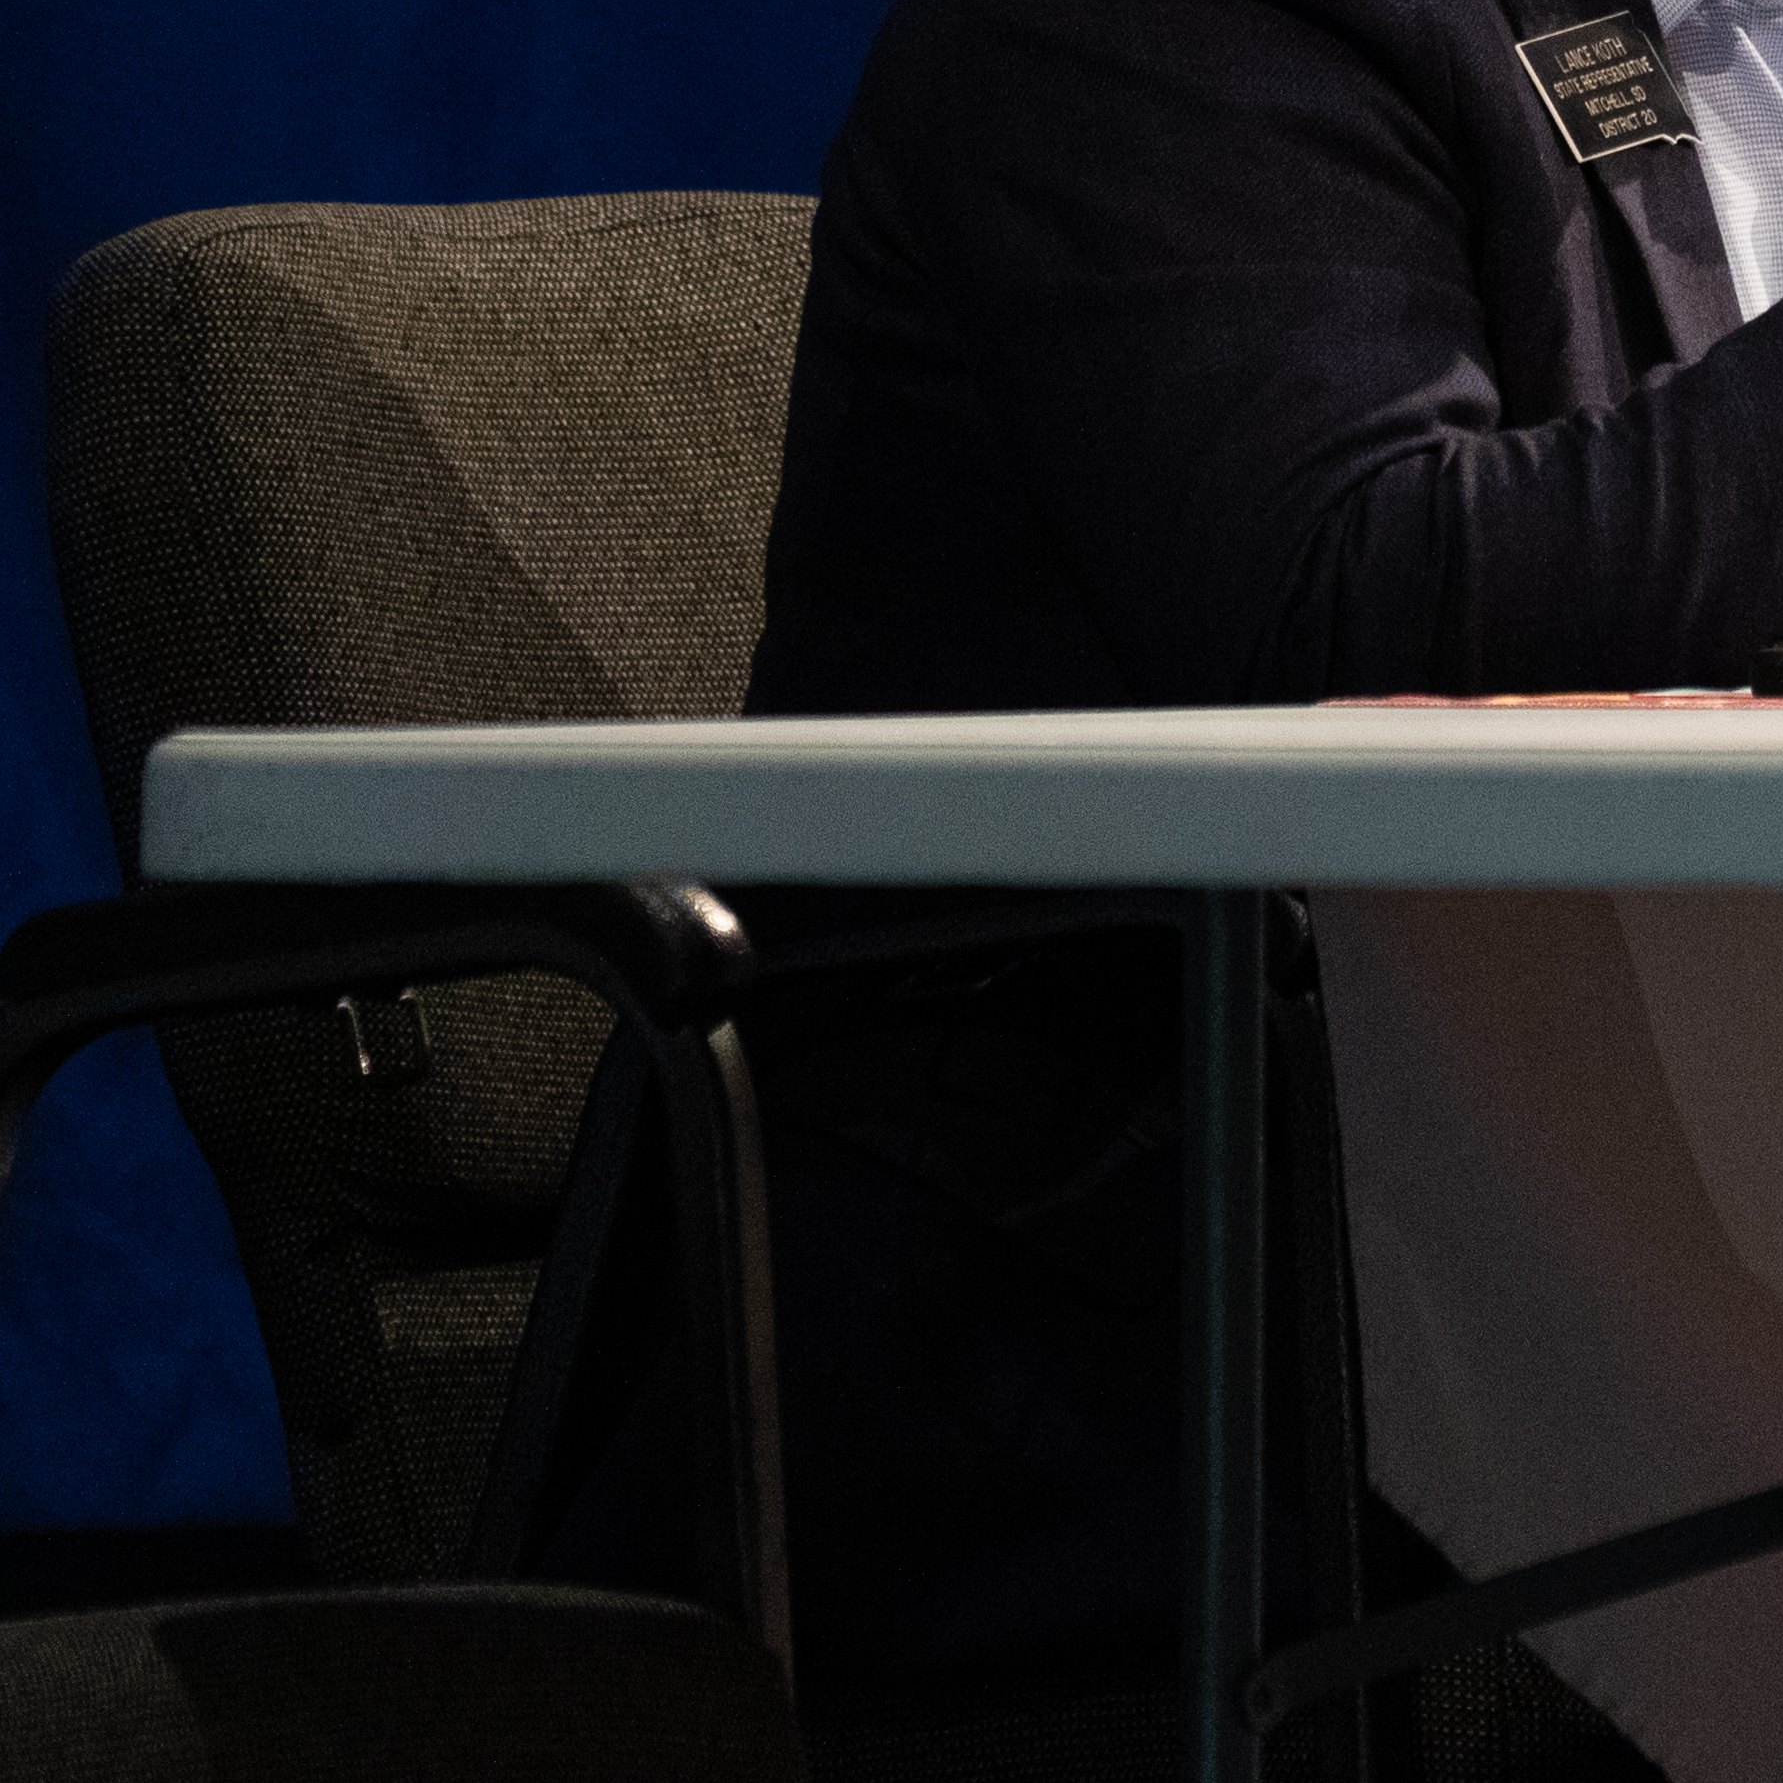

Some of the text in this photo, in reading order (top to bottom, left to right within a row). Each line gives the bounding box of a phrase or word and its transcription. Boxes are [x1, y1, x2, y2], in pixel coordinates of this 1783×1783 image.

[1555, 36, 1627, 73] LANCE KOTH
[1554, 56, 1653, 99] STATE REPRESENTATIVE
[1630, 85, 1646, 102] SD
[1598, 109, 1657, 138] DISTRICT 20
